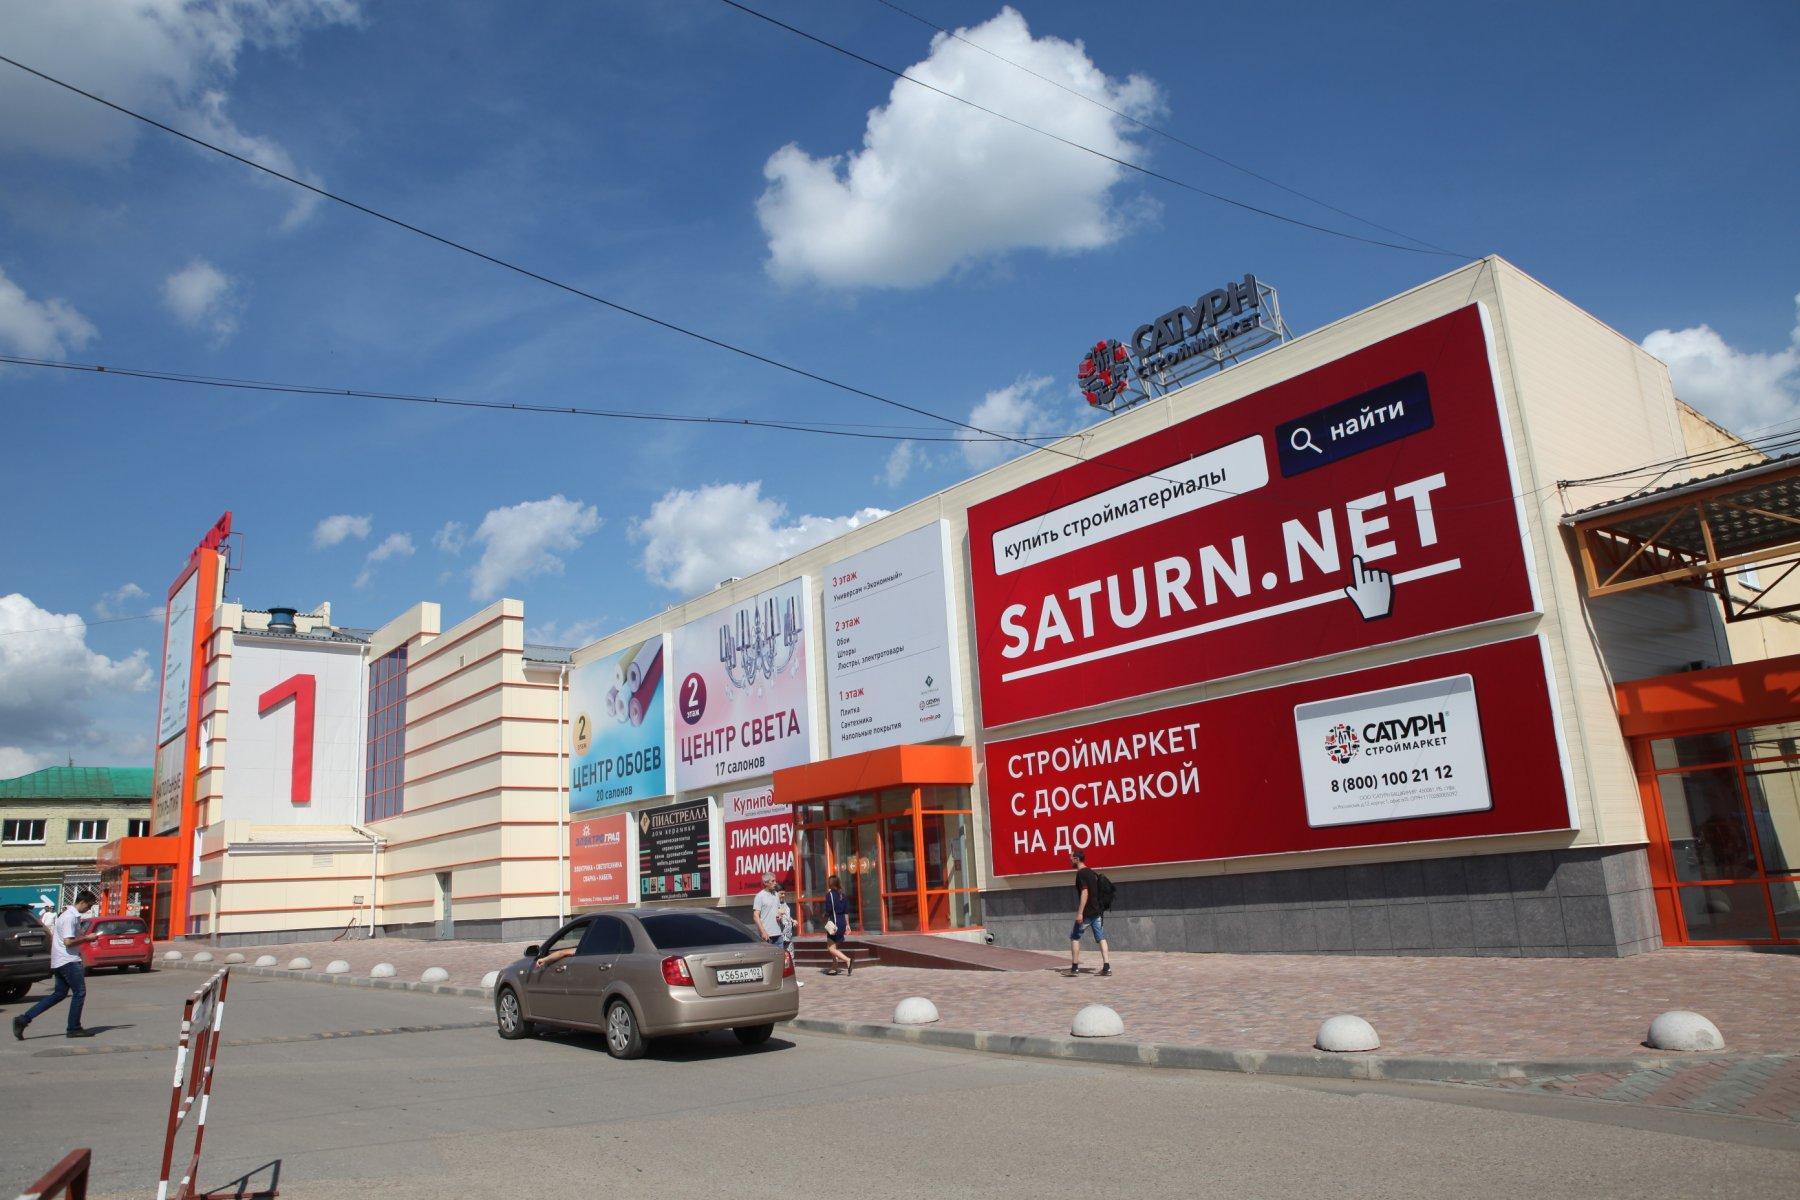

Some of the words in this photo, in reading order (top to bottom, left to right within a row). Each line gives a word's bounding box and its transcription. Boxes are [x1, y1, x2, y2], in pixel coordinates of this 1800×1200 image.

[1131, 273, 1259, 358] САТУРН
[1136, 312, 1261, 379] СТРОЙМАРКЕТ
[1330, 400, 1405, 442] найти
[1004, 526, 1059, 558] купить
[1063, 466, 1227, 537] стройматериалы
[1001, 472, 1447, 659] SATURN.NET
[832, 576, 837, 587] 3
[839, 571, 858, 586] этаж
[835, 621, 840, 632] 2
[841, 616, 860, 630] этаж
[836, 637, 850, 647] Обои
[837, 648, 857, 659] Шторы
[861, 645, 905, 664] электротовары
[688, 677, 699, 708] 2
[845, 687, 865, 700] этаж
[686, 708, 700, 719] этаж
[840, 706, 860, 717] Плитка
[841, 716, 873, 729] Сантехника
[258, 673, 316, 803] 1
[578, 715, 586, 741] 2
[681, 725, 737, 766] ЦЕНТР
[741, 708, 801, 748] СВЕТА
[841, 729, 873, 742] Напольные
[873, 722, 902, 735] покрытия
[1362, 711, 1447, 744] САТУРН
[1008, 722, 1201, 779] СТРОЙМАРКЕТ
[1365, 736, 1448, 757] СТРОЙМАРКЕТ
[573, 758, 613, 792] ЦЕНТР
[616, 746, 662, 778] ОБОЕВ
[715, 761, 726, 777] 17
[727, 756, 766, 774] салонов
[1331, 779, 1340, 793] 8
[1342, 774, 1378, 794] (800)
[1381, 770, 1408, 787] 100
[1412, 767, 1429, 783] 21
[1434, 764, 1453, 780] 12
[605, 786, 633, 800] салонов
[1010, 793, 1028, 818] С
[1032, 760, 1201, 819] ДОСТАВКОЙ
[651, 806, 708, 828] ПИАСТРЕЛЛА
[730, 822, 794, 850] ЛИНОЛЕУ
[1013, 827, 1047, 856] НА
[1053, 820, 1116, 858] ДОМ
[734, 850, 795, 876] ЛАМИНА
